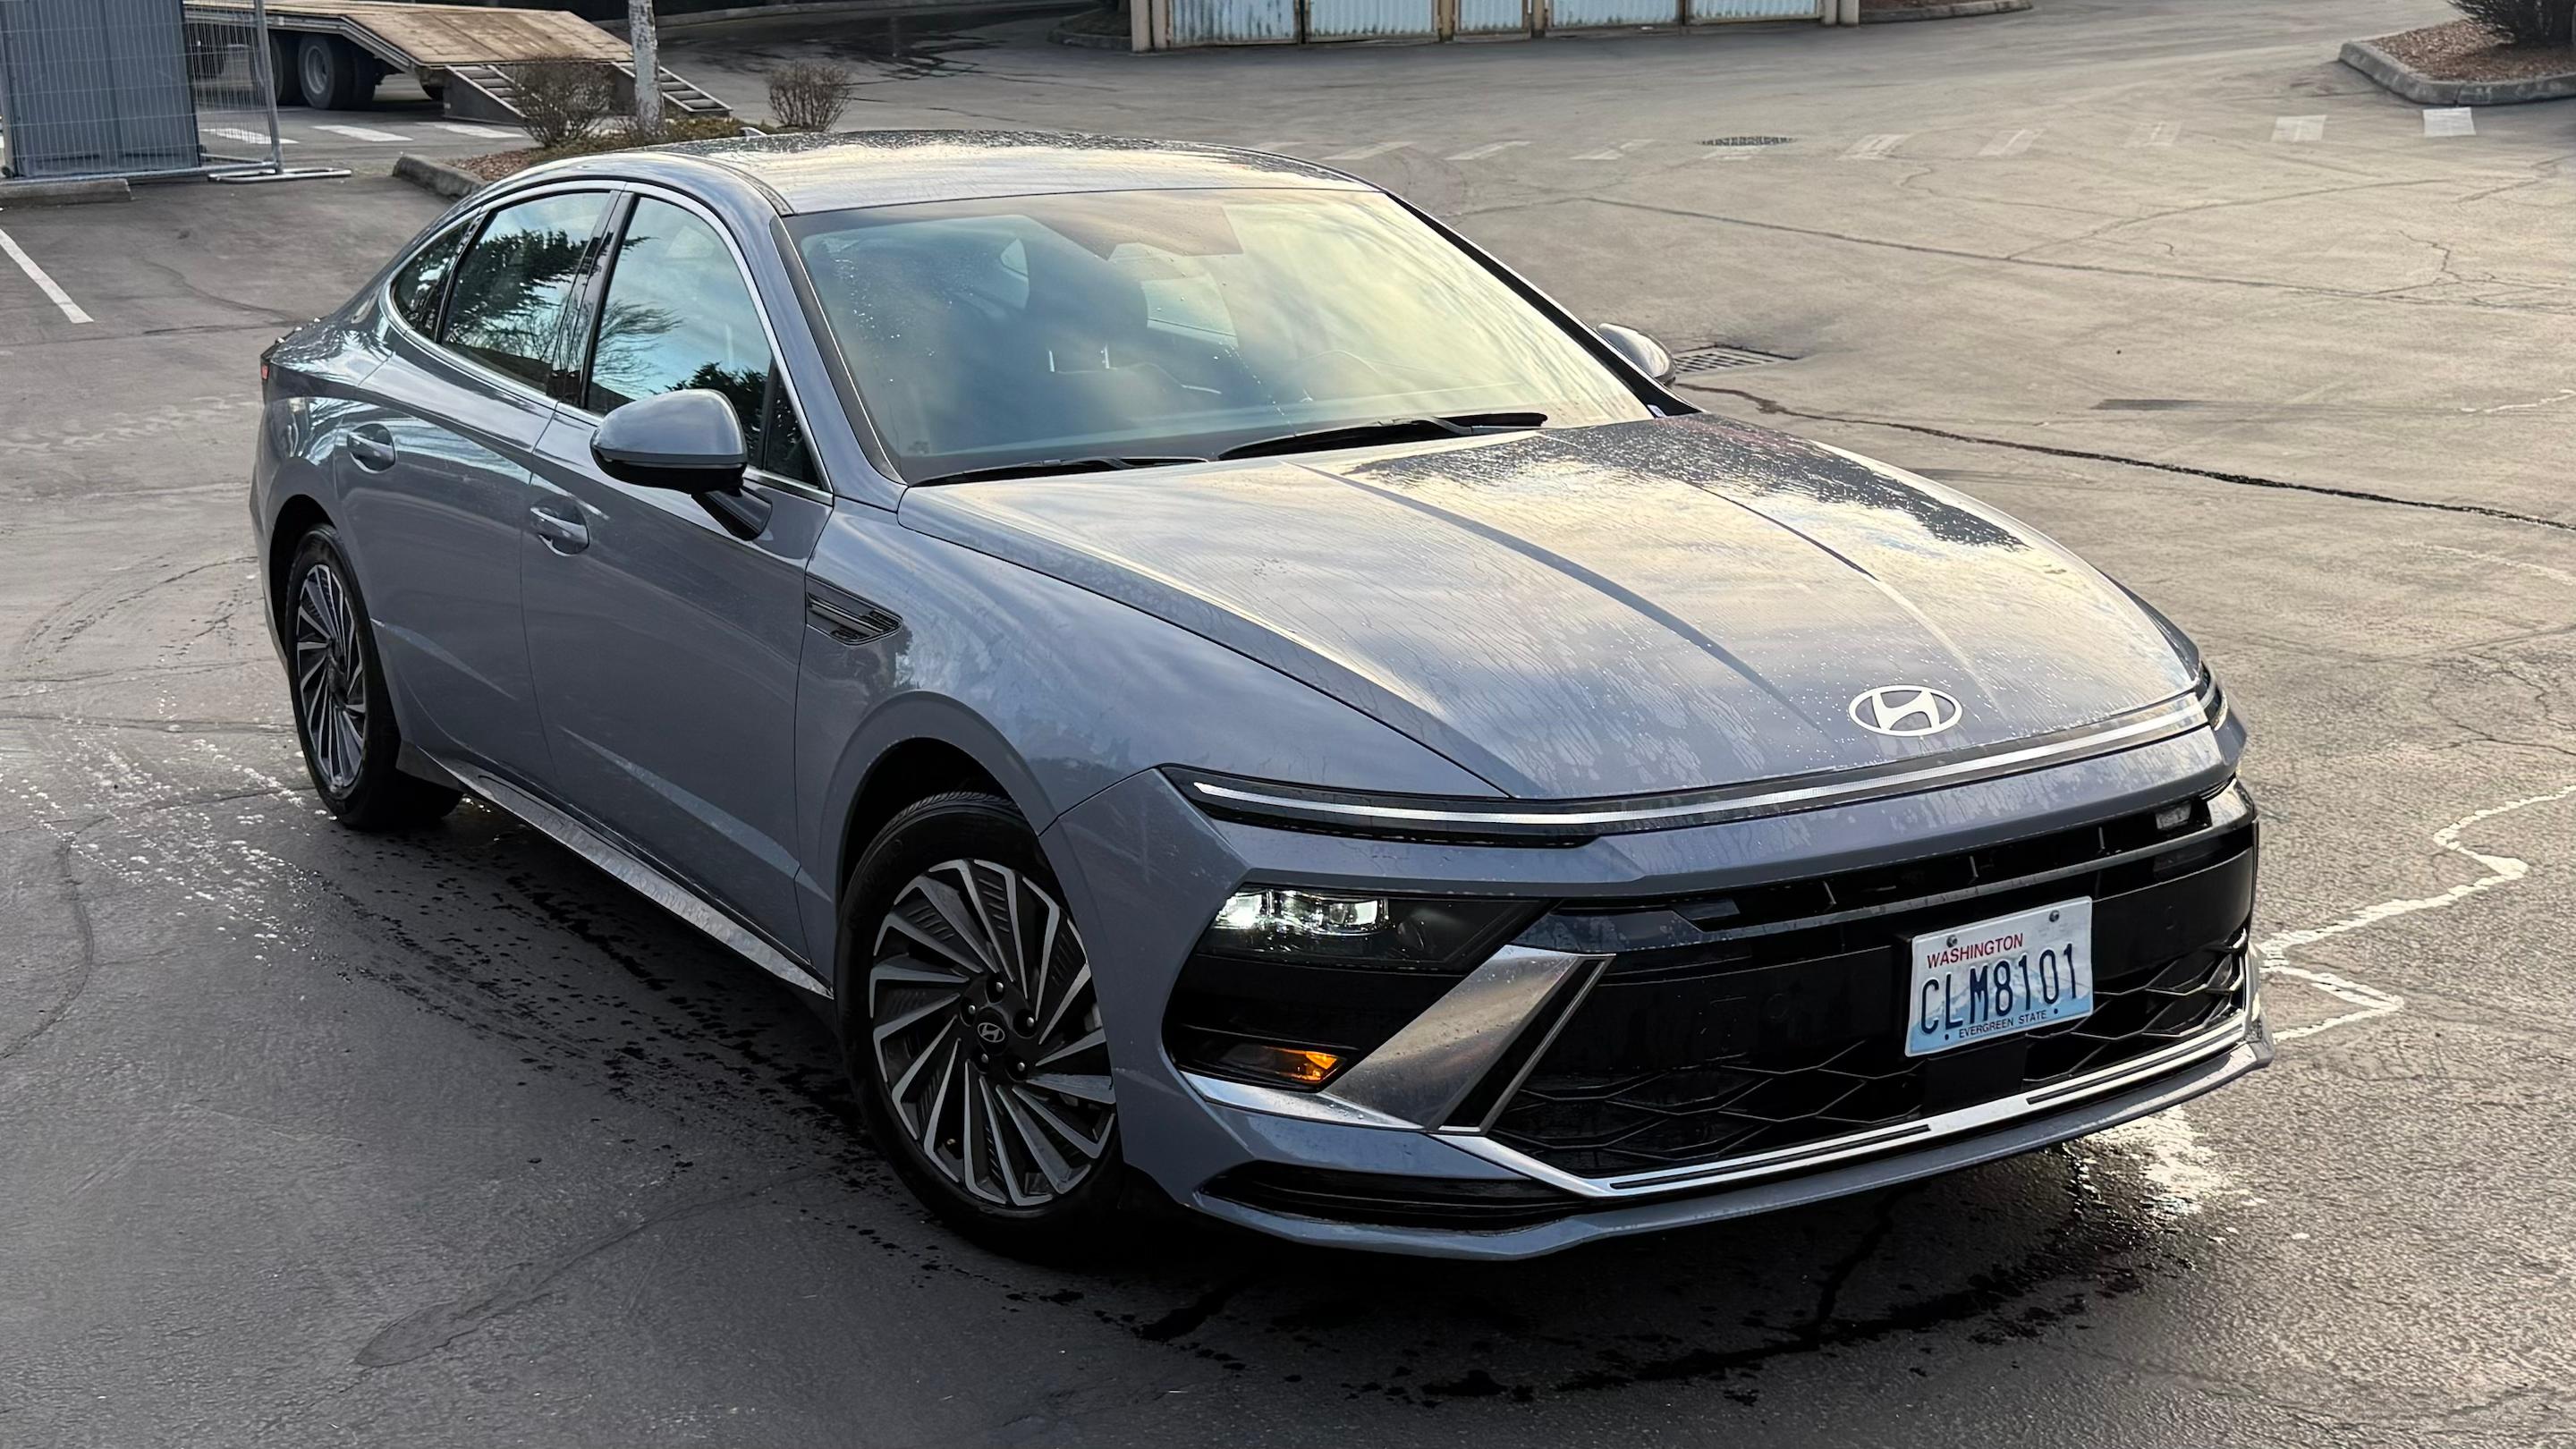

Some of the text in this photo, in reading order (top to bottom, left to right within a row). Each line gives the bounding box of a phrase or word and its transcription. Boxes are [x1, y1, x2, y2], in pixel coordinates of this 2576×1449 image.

[1927, 933, 2024, 969] WASHINGTON
[1920, 943, 2077, 1034] CLM8101
[1959, 1009, 2047, 1038] EVERGREEN STATE
